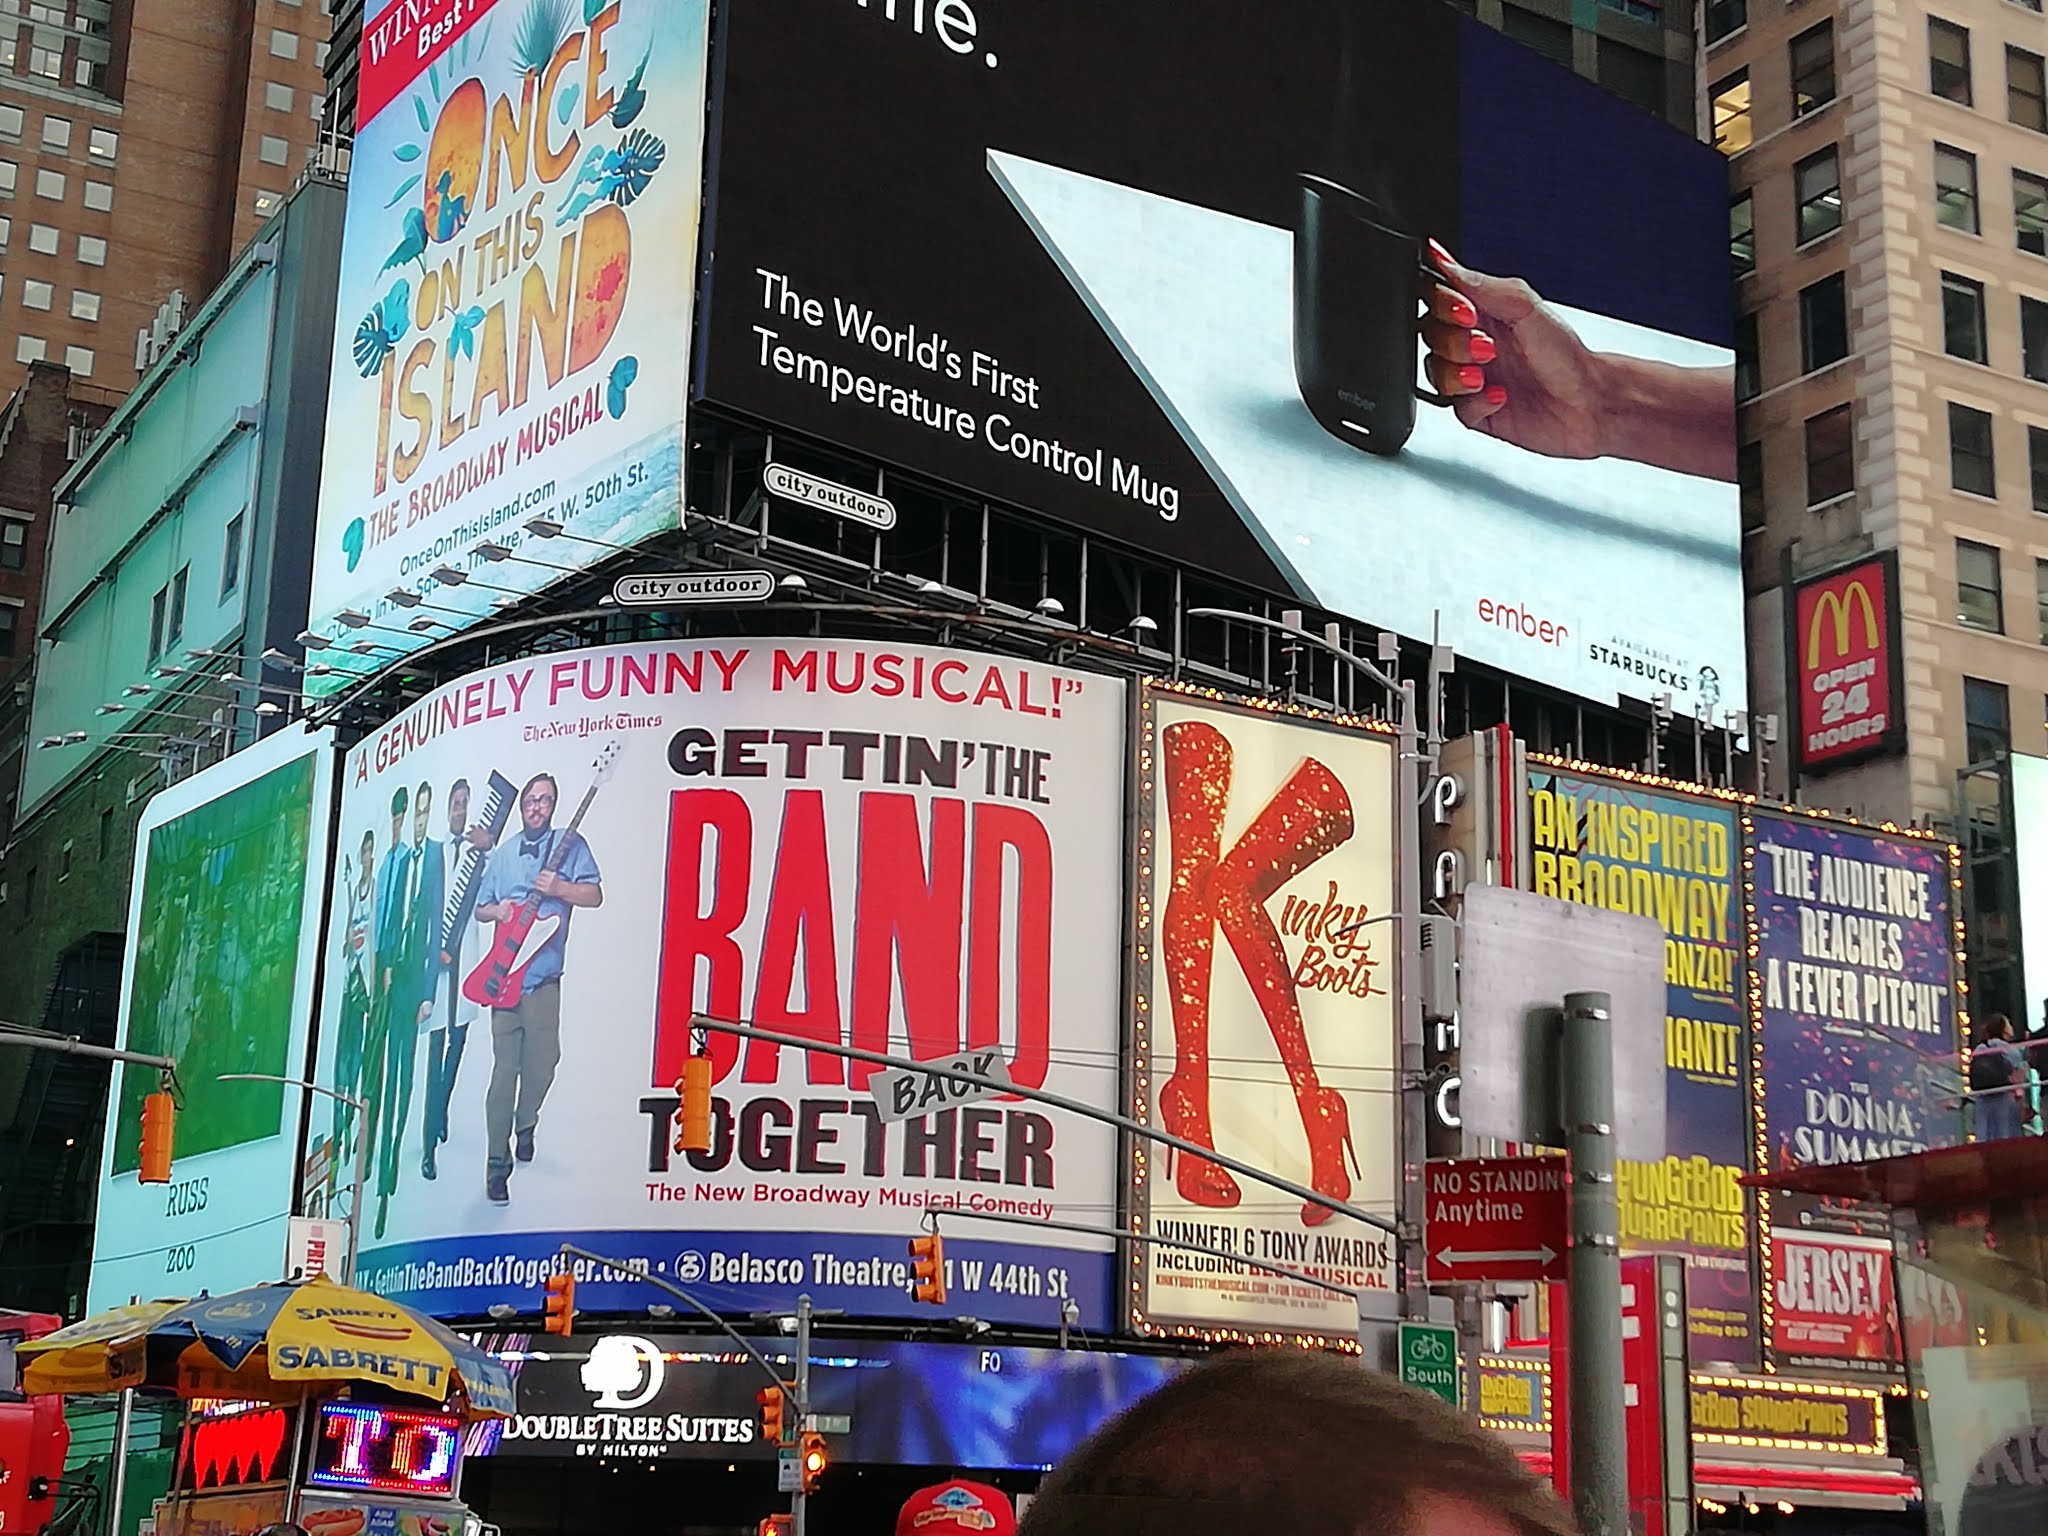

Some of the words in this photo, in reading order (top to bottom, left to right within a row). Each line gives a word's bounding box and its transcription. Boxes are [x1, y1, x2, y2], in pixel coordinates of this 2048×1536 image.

[417, 0, 462, 59] Best
[424, 3, 621, 244] ONCE
[415, 244, 465, 331] ON
[474, 191, 545, 297] THIS
[373, 203, 631, 498] ISLAND
[756, 268, 824, 327] The
[833, 297, 961, 379] World's
[972, 351, 1039, 409] First
[753, 326, 975, 440] Temperature
[985, 415, 1102, 486] Control
[1112, 459, 1179, 521] Mug
[369, 499, 400, 549] THE
[407, 437, 508, 528] BROADWAY
[516, 382, 603, 466] MUSICAL
[561, 495, 579, 522] W.
[585, 473, 622, 509] 50th
[627, 462, 649, 487] St.
[777, 474, 813, 498] city
[817, 487, 885, 519] outdoor
[400, 480, 556, 576] OnceOnThisIsland.com
[629, 582, 671, 598] city
[677, 580, 761, 594] outdoor
[1478, 598, 1569, 646] ember
[1590, 644, 1688, 691] STARBUCKS
[1813, 657, 1876, 692] OPEN
[375, 668, 534, 774] GENUINELY
[549, 649, 750, 706] FUNNY
[616, 712, 663, 730] Times
[1821, 682, 1870, 725] 24
[1808, 713, 1885, 751] HOURS
[667, 727, 975, 789] GETTIN'
[980, 742, 1052, 804] THE
[1586, 799, 1727, 878] INSPIRED
[1534, 850, 1730, 944] BROADWAY
[1820, 854, 1932, 922] AUDIENCE
[651, 788, 1053, 1103] BAND
[1799, 905, 1904, 971] REACHES
[1292, 945, 1387, 998] Boots
[1766, 957, 1784, 1010] A
[1787, 960, 1861, 1022] FEVER
[892, 1052, 996, 1115] BACK
[1804, 1087, 1916, 1138] DONNA
[639, 1096, 1055, 1190] TOGETHER
[166, 1177, 209, 1217] RUSS
[646, 1183, 686, 1201] The
[695, 1184, 745, 1202] New
[753, 1184, 870, 1208] Broadway
[879, 1188, 961, 1210] Musical
[969, 1192, 1054, 1219] Comedy
[1433, 1172, 1462, 1194] NO
[1434, 1200, 1524, 1226] Anytime
[166, 1245, 195, 1273] ZOO
[1156, 1219, 1239, 1257] WINNER!
[1244, 1227, 1255, 1257] 6
[1260, 1229, 1310, 1264] TONY
[1314, 1235, 1389, 1271] AWARDS
[1156, 1252, 1245, 1276] INCLUDING
[1304, 1266, 1389, 1289] MUSICAL
[710, 1251, 801, 1284] Belasco
[812, 1253, 914, 1293] Theatre,
[962, 1260, 983, 1291] W
[989, 1262, 1041, 1295] 44th
[1047, 1267, 1068, 1298] St
[1777, 1243, 1883, 1318] JERSEY
[296, 1306, 398, 1320] SABRETT
[278, 1346, 443, 1388] SABRETT
[1407, 1365, 1453, 1385] South
[576, 1443, 594, 1456] BY
[665, 1413, 752, 1443] SUITES
